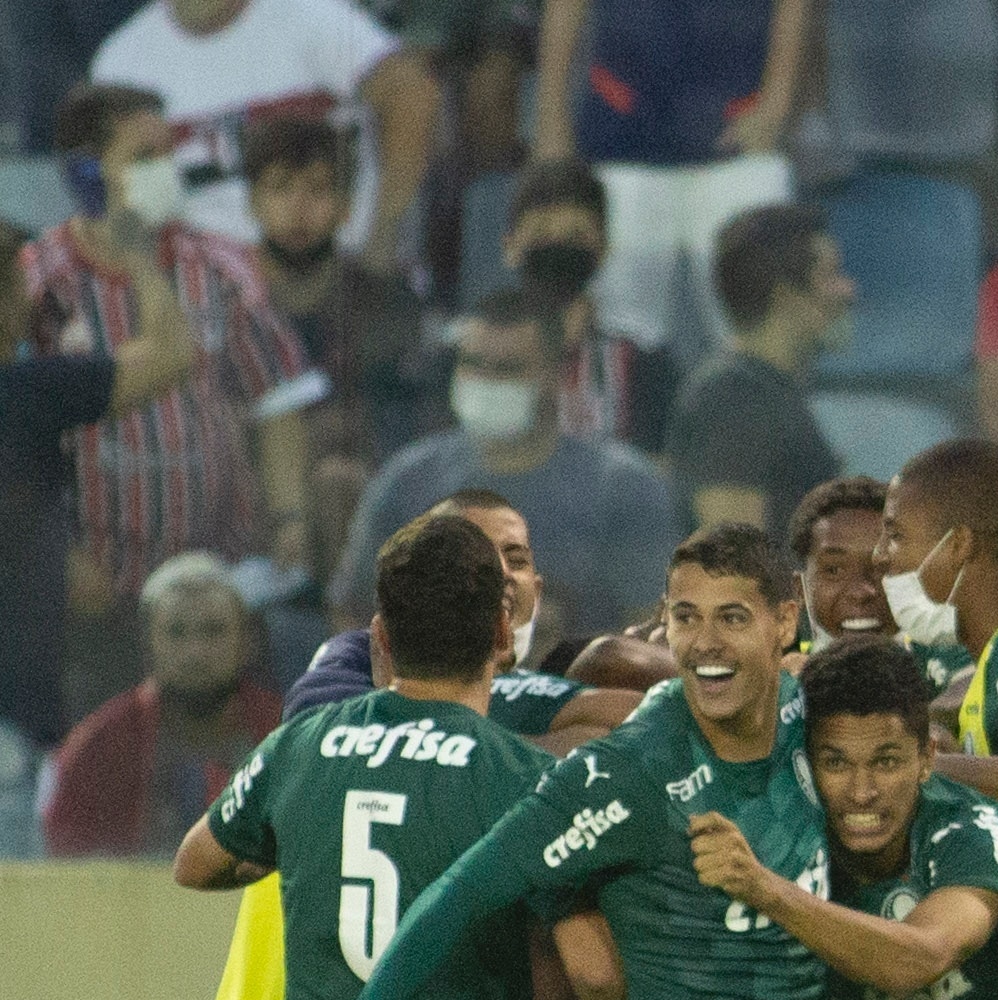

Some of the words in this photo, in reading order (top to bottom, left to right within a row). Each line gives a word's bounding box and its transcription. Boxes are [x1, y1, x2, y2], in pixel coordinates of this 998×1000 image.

[320, 718, 476, 768] crefisa
[356, 800, 389, 814] crefisa
[542, 799, 630, 869] crefisa
[338, 789, 407, 983] 5
